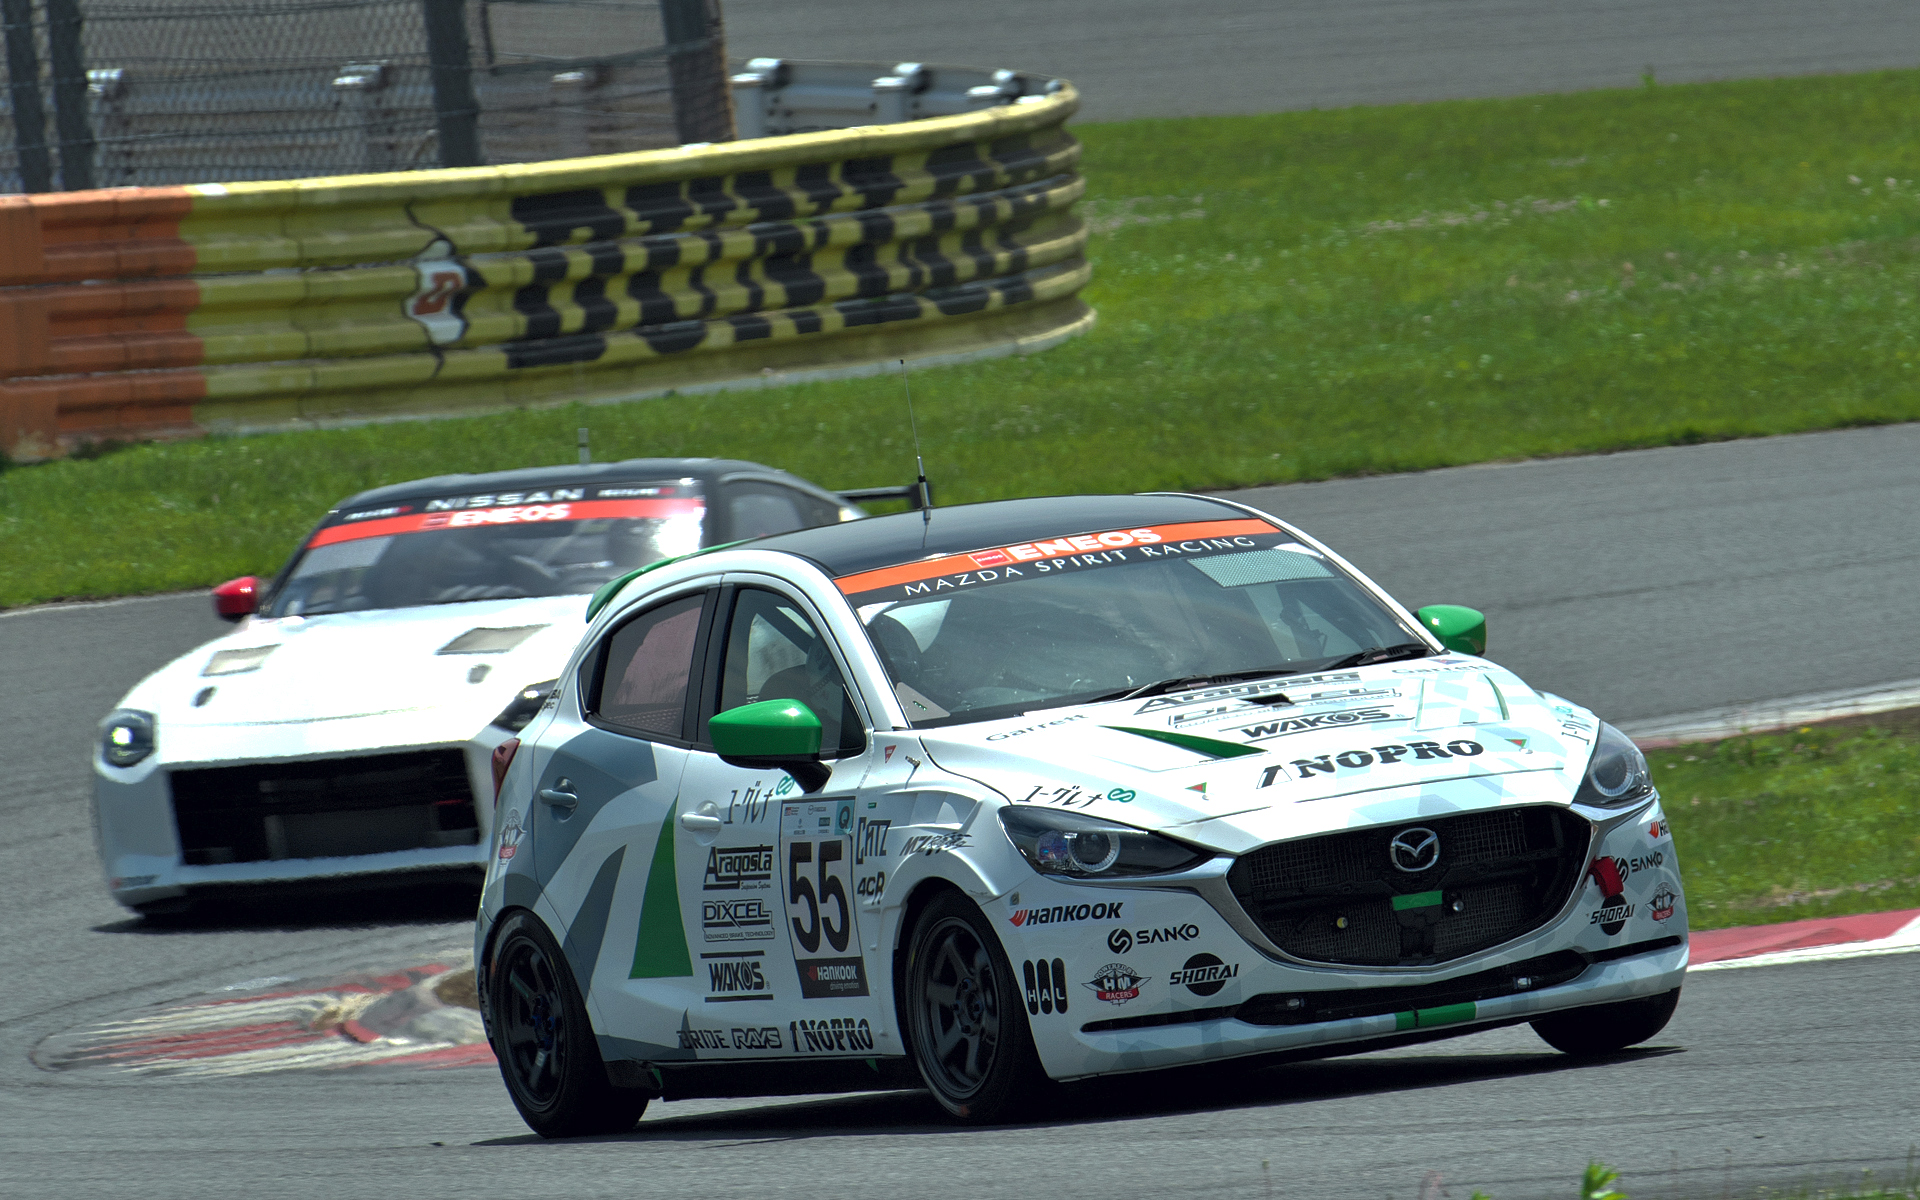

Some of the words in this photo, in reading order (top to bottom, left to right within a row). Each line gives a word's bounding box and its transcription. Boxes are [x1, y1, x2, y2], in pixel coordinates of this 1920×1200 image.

[426, 488, 585, 512] NISSAN
[448, 504, 572, 527] ENEOS
[1006, 529, 1162, 560] ENEOS
[904, 567, 1024, 596] MAZDA
[1034, 549, 1128, 573] SPIRIT
[1139, 536, 1256, 558] RACING
[986, 714, 1090, 741] Garrett
[838, 805, 851, 830] Q
[703, 844, 774, 886] Aragosta
[1630, 850, 1665, 873] SANKO
[789, 839, 851, 954] 55
[703, 901, 771, 923] DIXCEL
[1589, 904, 1636, 925] SHORAI
[1136, 923, 1200, 945] SANKO
[1169, 963, 1240, 986] SHORAI
[1027, 987, 1066, 1003] HAL
[1105, 991, 1133, 1000] RACERS
[731, 1026, 783, 1050] RAYS
